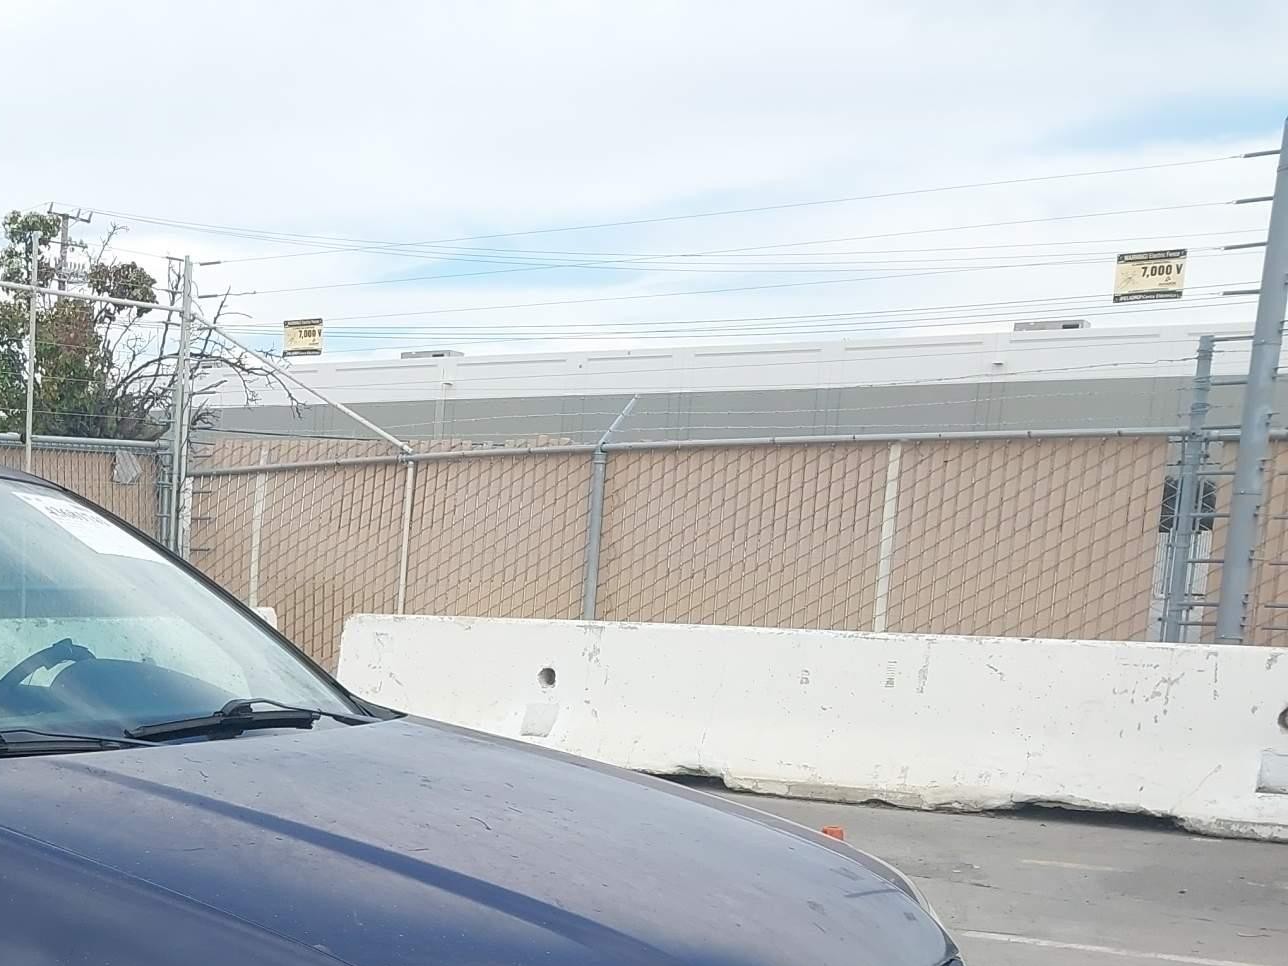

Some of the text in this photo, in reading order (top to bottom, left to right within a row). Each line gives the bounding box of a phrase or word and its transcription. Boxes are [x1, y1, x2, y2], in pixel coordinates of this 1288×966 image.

[1141, 263, 1184, 278] 7,000 V
[298, 329, 317, 340] 7,000
